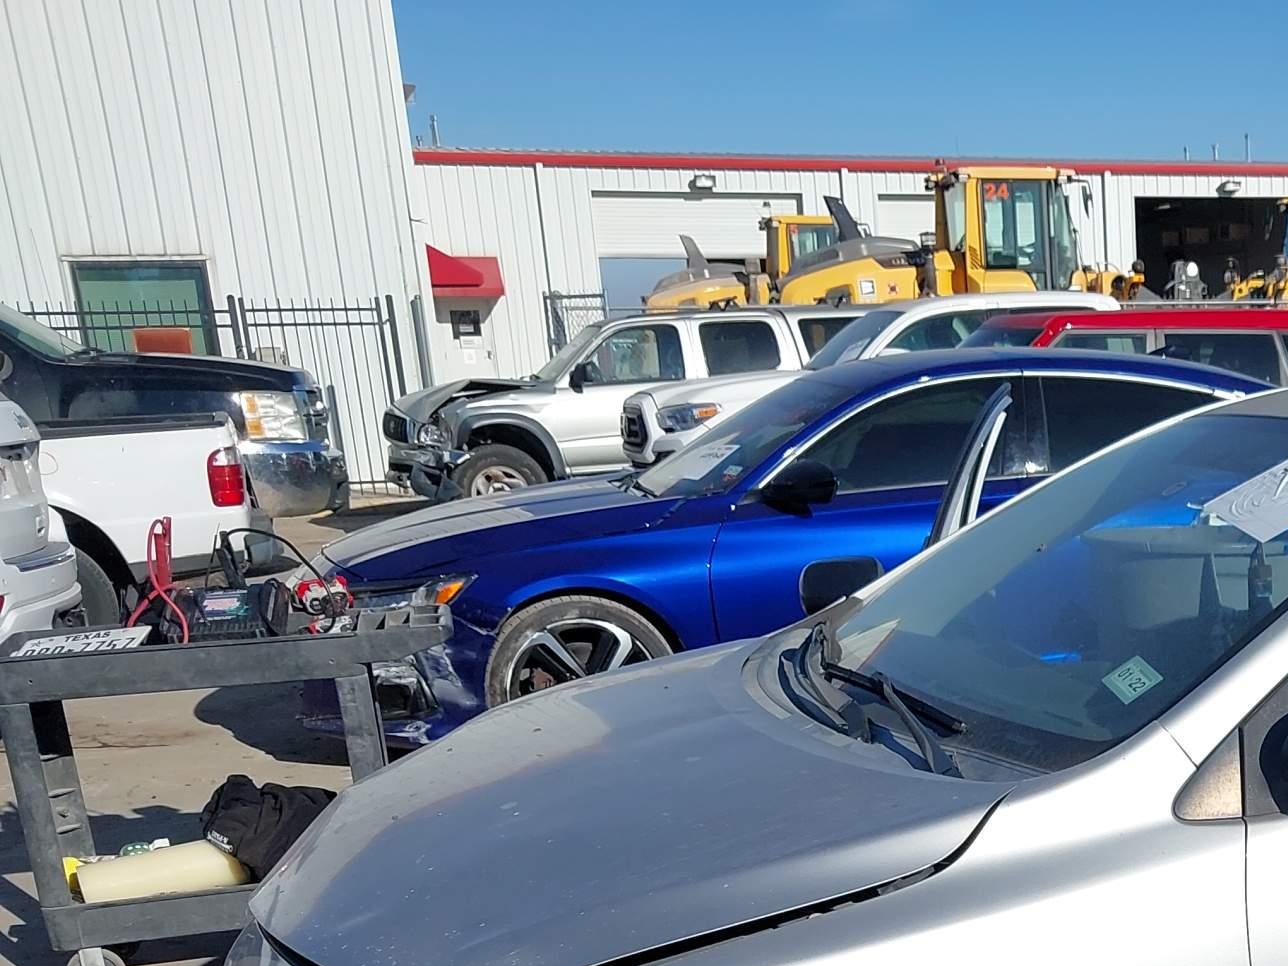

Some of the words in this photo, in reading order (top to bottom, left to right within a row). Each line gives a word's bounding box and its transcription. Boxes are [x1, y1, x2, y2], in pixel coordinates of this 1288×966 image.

[983, 182, 1010, 200] 24
[64, 631, 111, 643] TEXAS
[1127, 677, 1147, 693] 22
